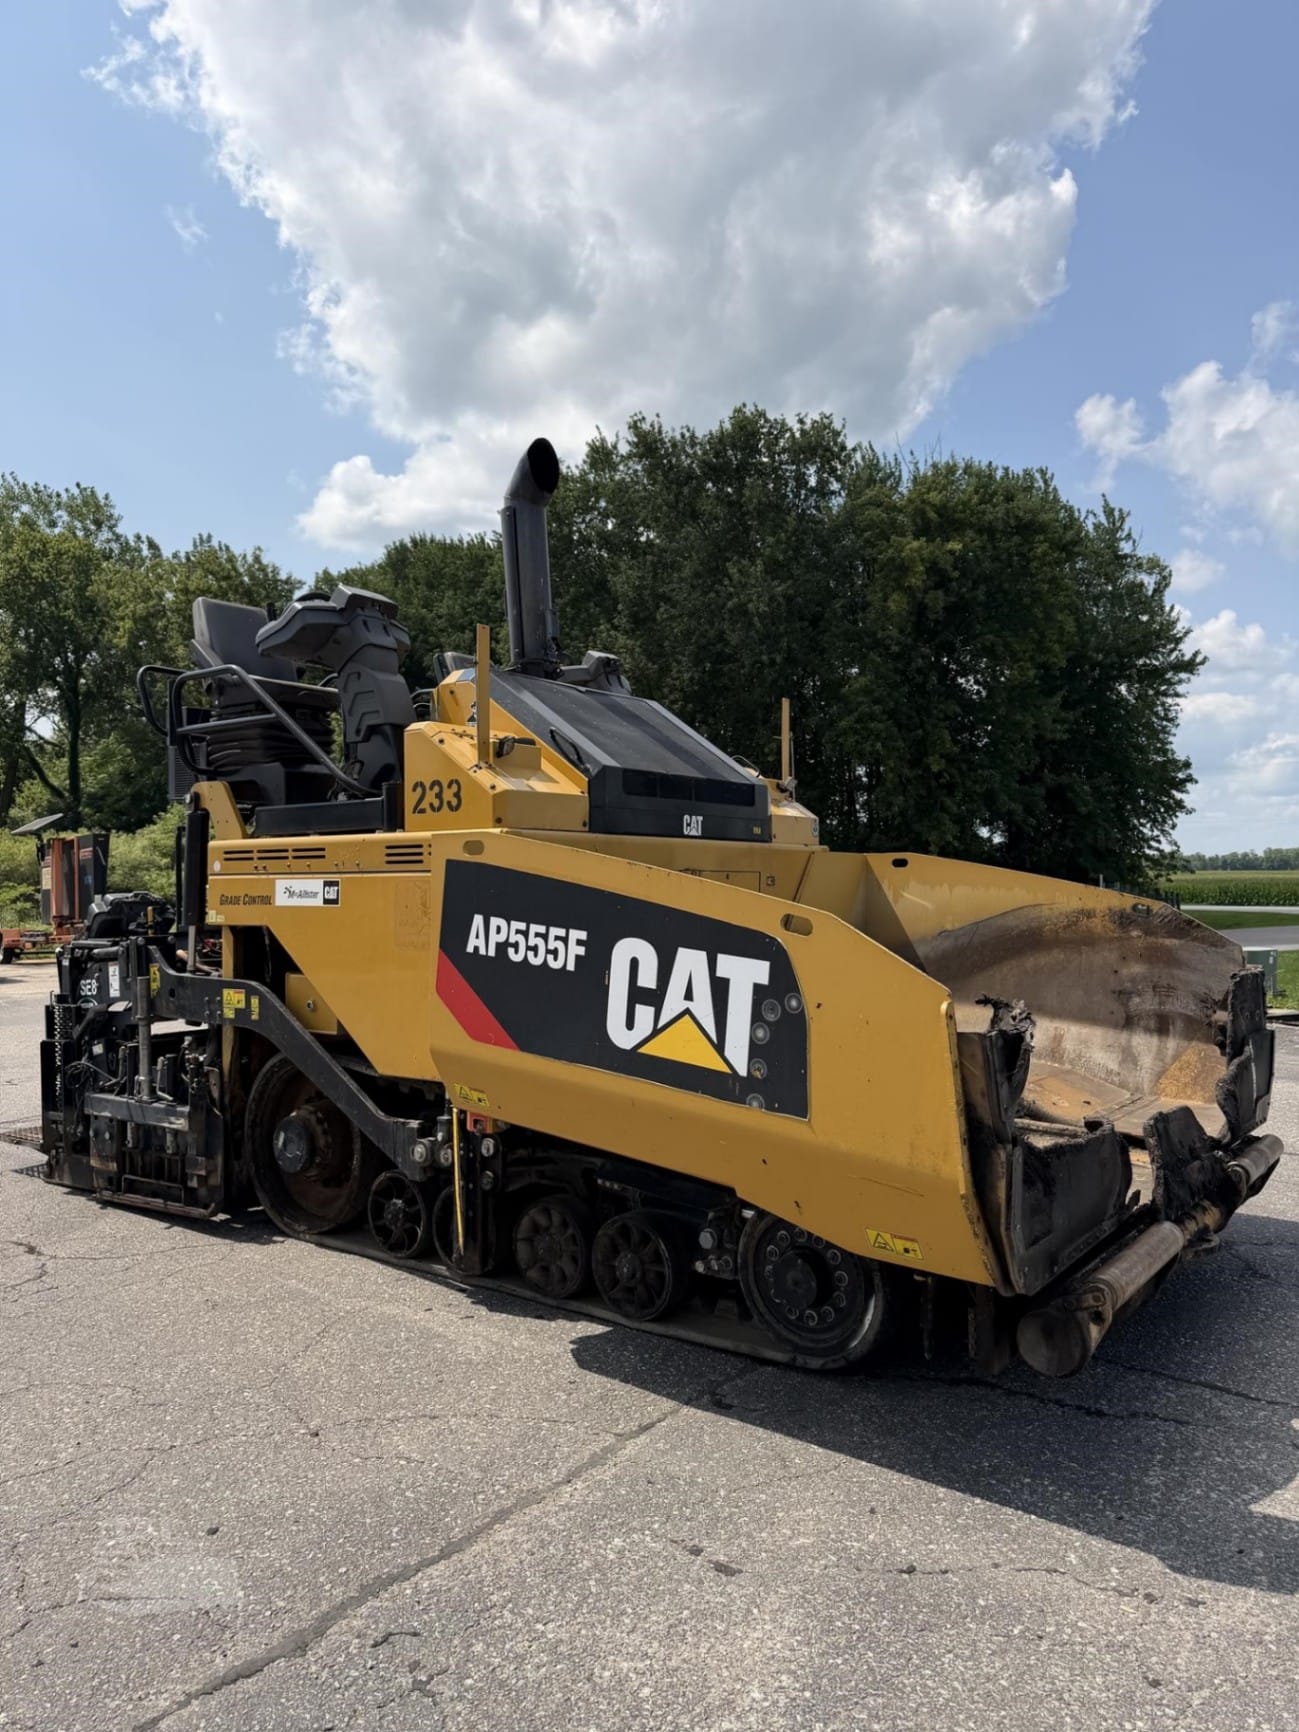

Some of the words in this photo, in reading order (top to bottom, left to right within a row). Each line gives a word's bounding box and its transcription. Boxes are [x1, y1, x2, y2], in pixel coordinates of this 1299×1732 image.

[412, 778, 462, 814] 233
[683, 814, 703, 836] CAT
[220, 894, 241, 906] GRADE
[242, 893, 272, 906] CONTROL
[465, 914, 588, 972] AP555F
[606, 936, 770, 1078] CAT
